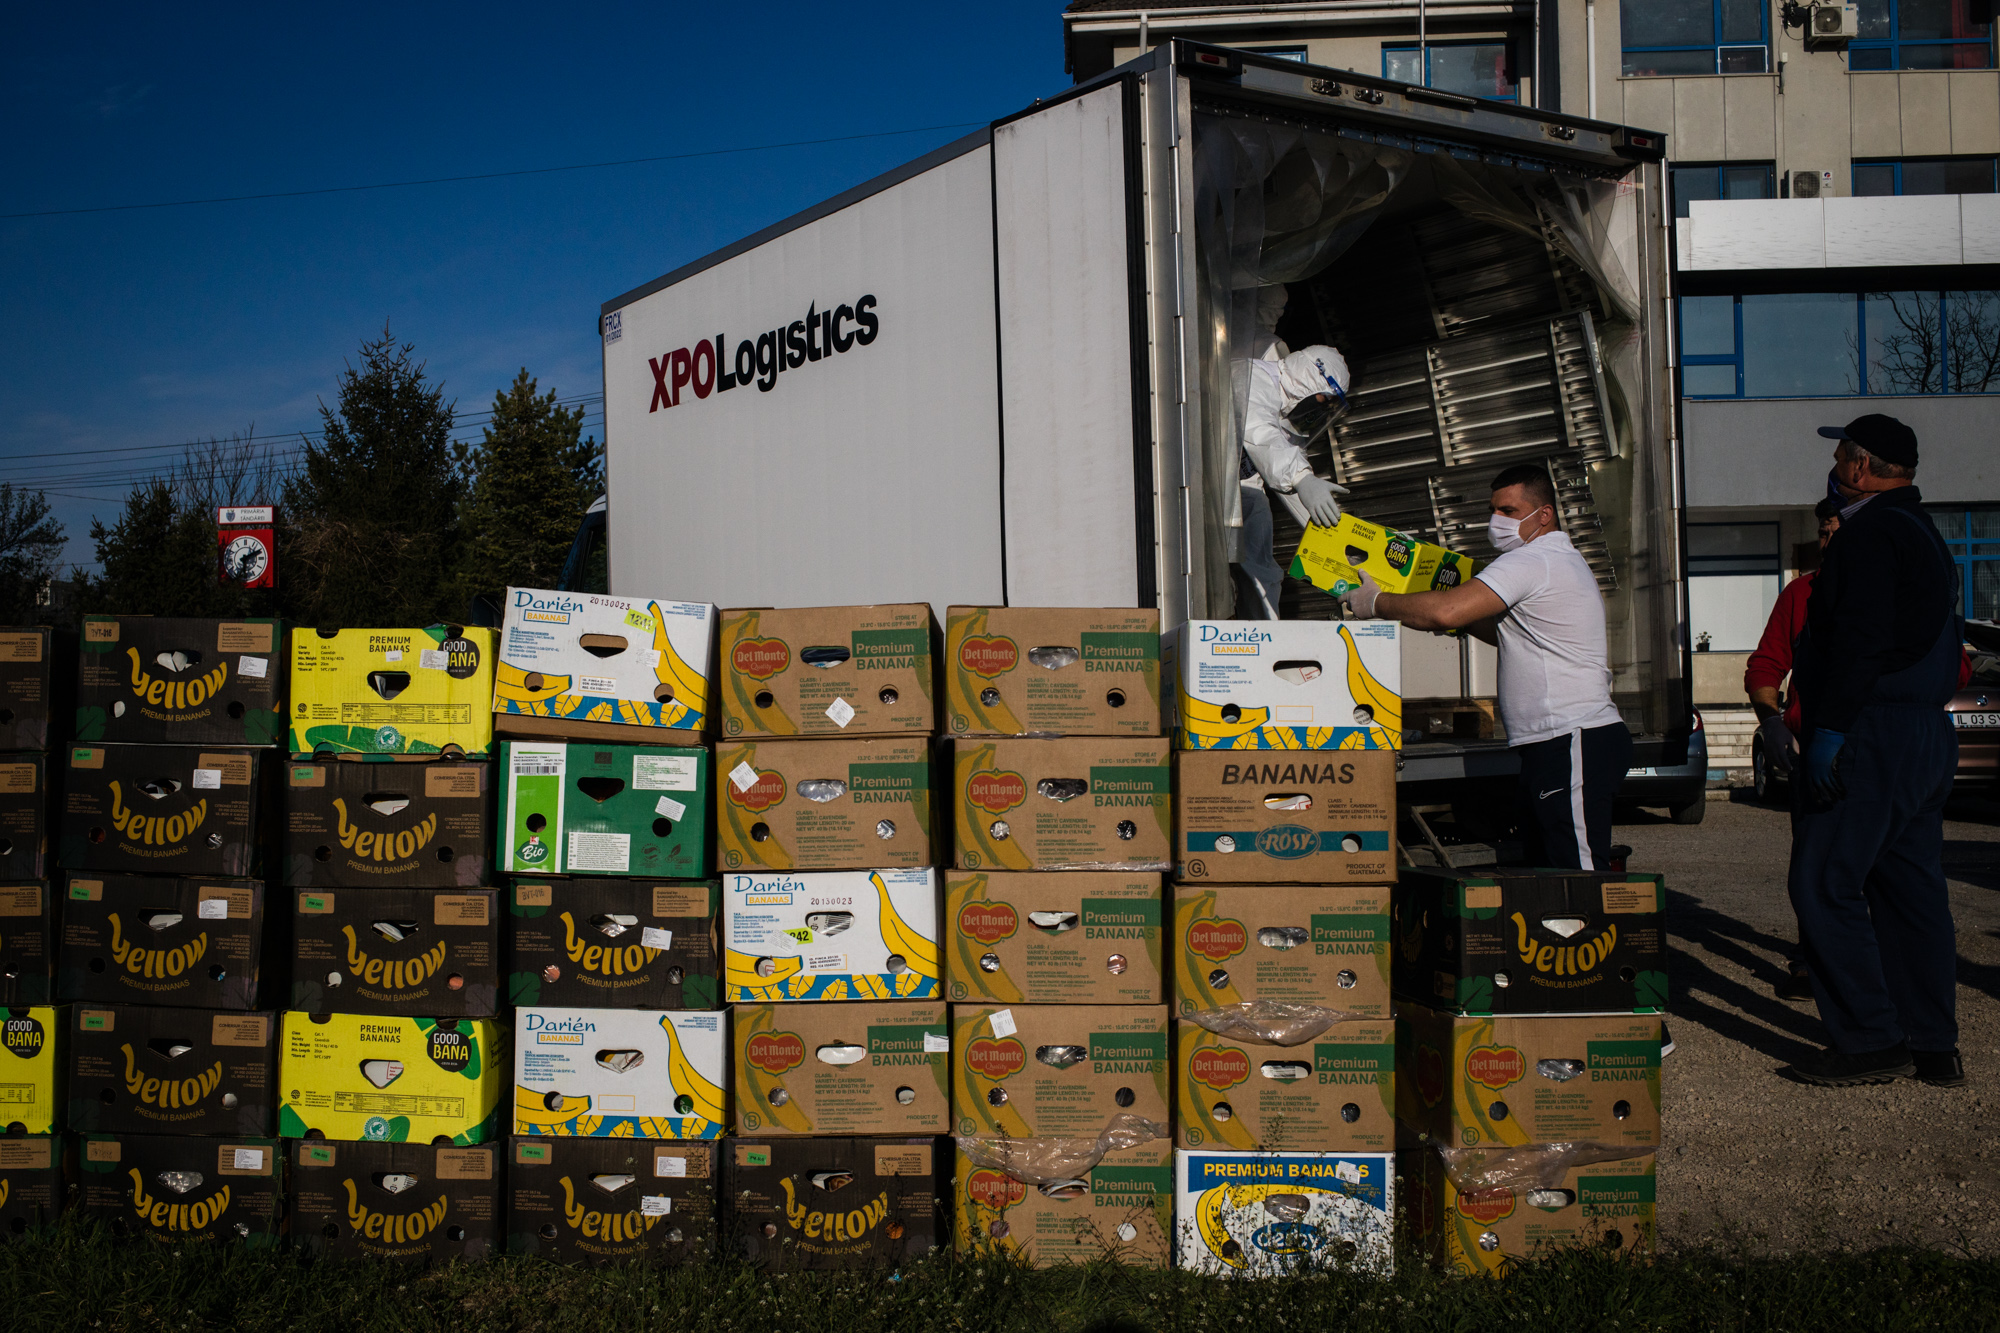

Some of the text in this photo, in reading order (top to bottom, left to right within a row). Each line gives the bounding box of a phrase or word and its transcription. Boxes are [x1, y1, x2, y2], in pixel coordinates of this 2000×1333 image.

[605, 311, 622, 333] FRCX
[1351, 529, 1374, 542] BANANAS
[1353, 523, 1376, 536] PREMIUM
[1390, 541, 1406, 553] GOOD
[1387, 549, 1408, 565] BANA
[1439, 568, 1456, 586] GOOD
[514, 591, 583, 612] Darién
[527, 612, 567, 623] BANANAS
[1199, 625, 1272, 642] Darién
[369, 636, 411, 644] PREMIUM
[443, 641, 467, 651] GOOD
[856, 643, 914, 654] Premium
[964, 648, 1014, 660] Del Monte
[1085, 645, 1144, 656] Premium
[737, 650, 787, 662] Del Monte
[751, 662, 772, 671] Quality
[856, 658, 925, 670] BANANAS
[978, 660, 1000, 669] Quality
[1085, 661, 1153, 672] BANANAS
[126, 646, 228, 710] yellow
[140, 707, 212, 722] PREMIUM BANANAS
[1957, 715, 1967, 725] IL
[1970, 714, 1985, 725] 03
[1221, 764, 1355, 785] BANANAS
[853, 776, 912, 787] Premium
[1094, 780, 1153, 791] Premium
[972, 784, 1022, 795] Del Monte
[746, 795, 767, 803] Quality
[853, 792, 923, 803] BANANAS
[986, 796, 1007, 804] Quality
[1094, 796, 1163, 807] BANANAS
[108, 780, 207, 845] yellow
[332, 798, 437, 861] yellow
[1265, 832, 1310, 851] ROSY
[118, 842, 189, 858] PREMIUM BANANAS
[522, 845, 545, 860] Bio
[347, 860, 420, 874] PREMIUM BANANAS
[1191, 863, 1202, 874] G
[734, 875, 805, 892] Darién
[749, 896, 790, 904] BANANAS
[964, 914, 1014, 925] Del Monte
[1085, 912, 1145, 923] Premium
[977, 927, 999, 935] Quality
[1086, 928, 1155, 939] BANANAS
[1192, 931, 1243, 943] Del Monte
[1315, 928, 1375, 939] Premium
[107, 912, 207, 979] yellow
[1206, 944, 1228, 953] Quality
[1315, 944, 1385, 955] BANANAS
[1510, 911, 1617, 976] yellow
[342, 924, 446, 989] yellow
[119, 975, 190, 992] PREMIUM BANANAS
[576, 974, 650, 988] PREMIUM BANANAS
[1529, 973, 1603, 989] PREMIUM BANANAS
[356, 987, 429, 1002] PREMIUM BANANAS
[7, 1020, 33, 1032] GOOD
[526, 1014, 596, 1032] Darién
[360, 1025, 401, 1034] PREMIUM
[7, 1032, 42, 1047] BANA
[360, 1034, 401, 1043] BANANAS
[433, 1033, 459, 1045] GOOD
[540, 1035, 581, 1043] BANANAS
[433, 1045, 469, 1060] BANA
[751, 1044, 801, 1056] Del Monte
[971, 1049, 1022, 1062] Del Monte
[1093, 1046, 1153, 1057] Premium
[765, 1057, 786, 1066] Quality
[872, 1054, 941, 1066] BANANAS
[1195, 1060, 1246, 1072] Del Monte
[1318, 1057, 1378, 1068] Premium
[1471, 1059, 1521, 1071] Del Monte
[1591, 1054, 1647, 1066] Premium
[985, 1062, 1007, 1071] Quality
[1094, 1062, 1163, 1073] BANANAS
[121, 1042, 222, 1108] yellow
[1209, 1072, 1231, 1081] Quality
[1319, 1073, 1388, 1084] BANANAS
[1485, 1072, 1507, 1080] Quality
[1592, 1070, 1656, 1082] BANANAS
[134, 1105, 206, 1122] PREMIUM BANANAS
[1204, 1163, 1284, 1177] PREMIUM
[973, 1182, 989, 1192] Del
[1095, 1179, 1154, 1191] Premium
[128, 1167, 230, 1231] yellow
[1581, 1189, 1639, 1201] Premium
[342, 1178, 447, 1243] yellow
[780, 1177, 887, 1242] yellow
[1475, 1207, 1497, 1215] Quality
[575, 1239, 611, 1255] PREMIUM
[797, 1241, 833, 1255] PREMIUM
